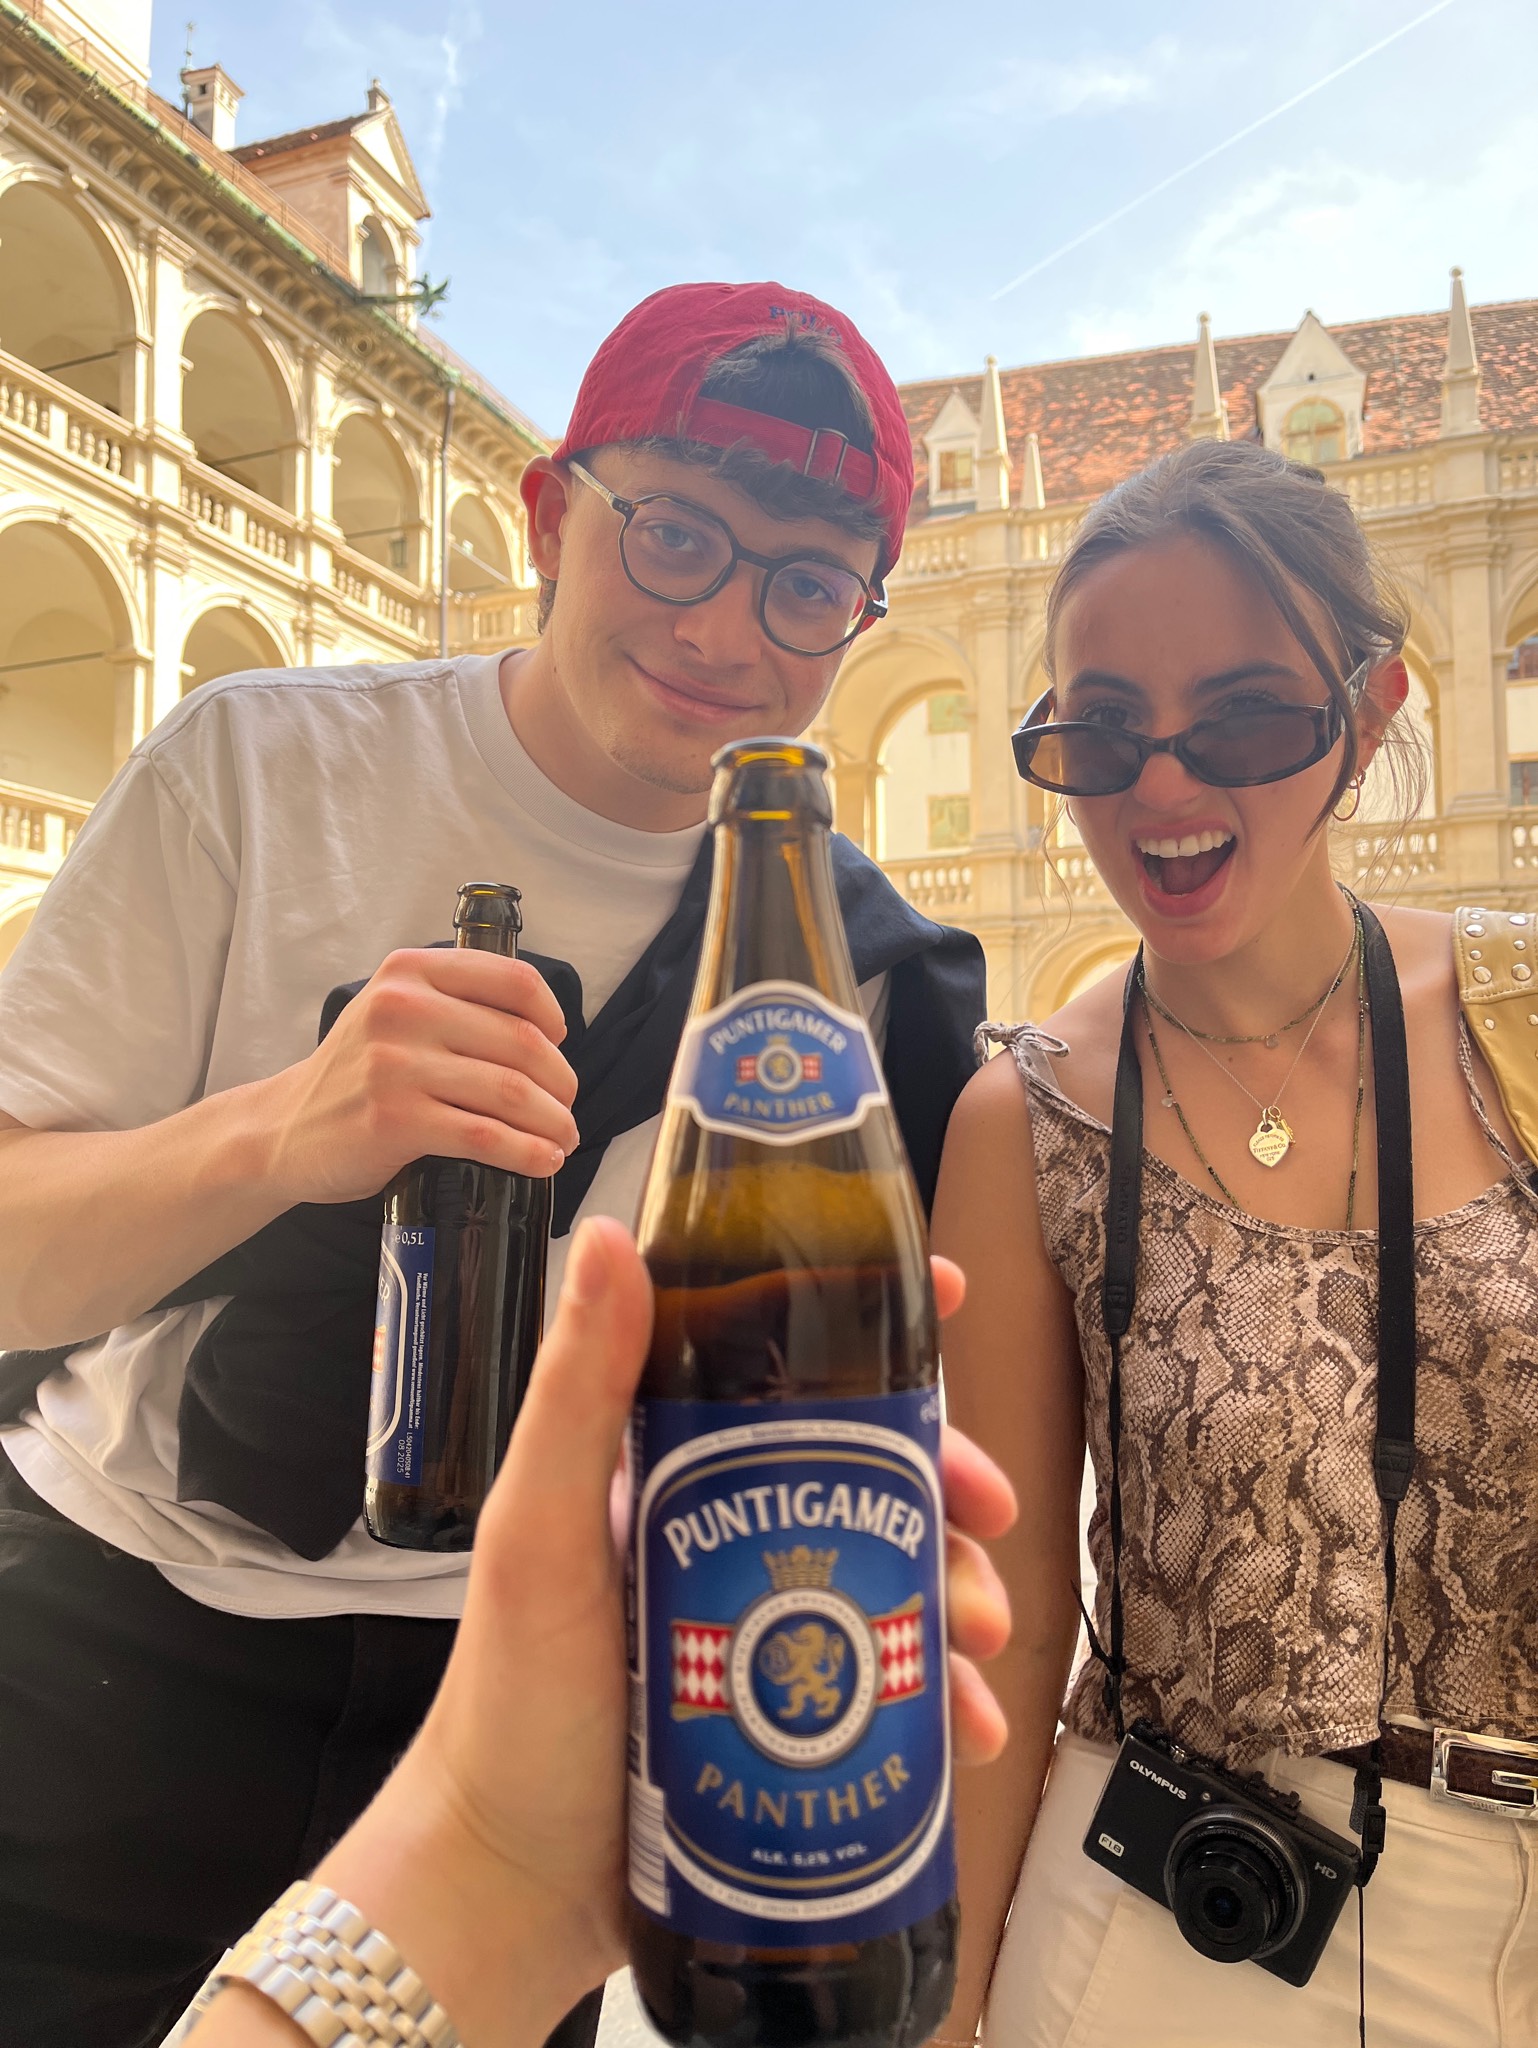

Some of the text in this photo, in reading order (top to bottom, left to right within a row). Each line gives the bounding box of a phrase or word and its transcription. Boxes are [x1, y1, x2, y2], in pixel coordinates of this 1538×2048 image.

[708, 1007, 848, 1055] PUNTIGAMER
[723, 1091, 836, 1120] PANTHER
[396, 1440, 406, 1474] 08 2025
[663, 1481, 925, 1570] PUNTIGAMER
[695, 1753, 911, 1830] PANTHER
[1130, 1760, 1187, 1800] OLYMPUS
[1315, 1861, 1338, 1879] HD
